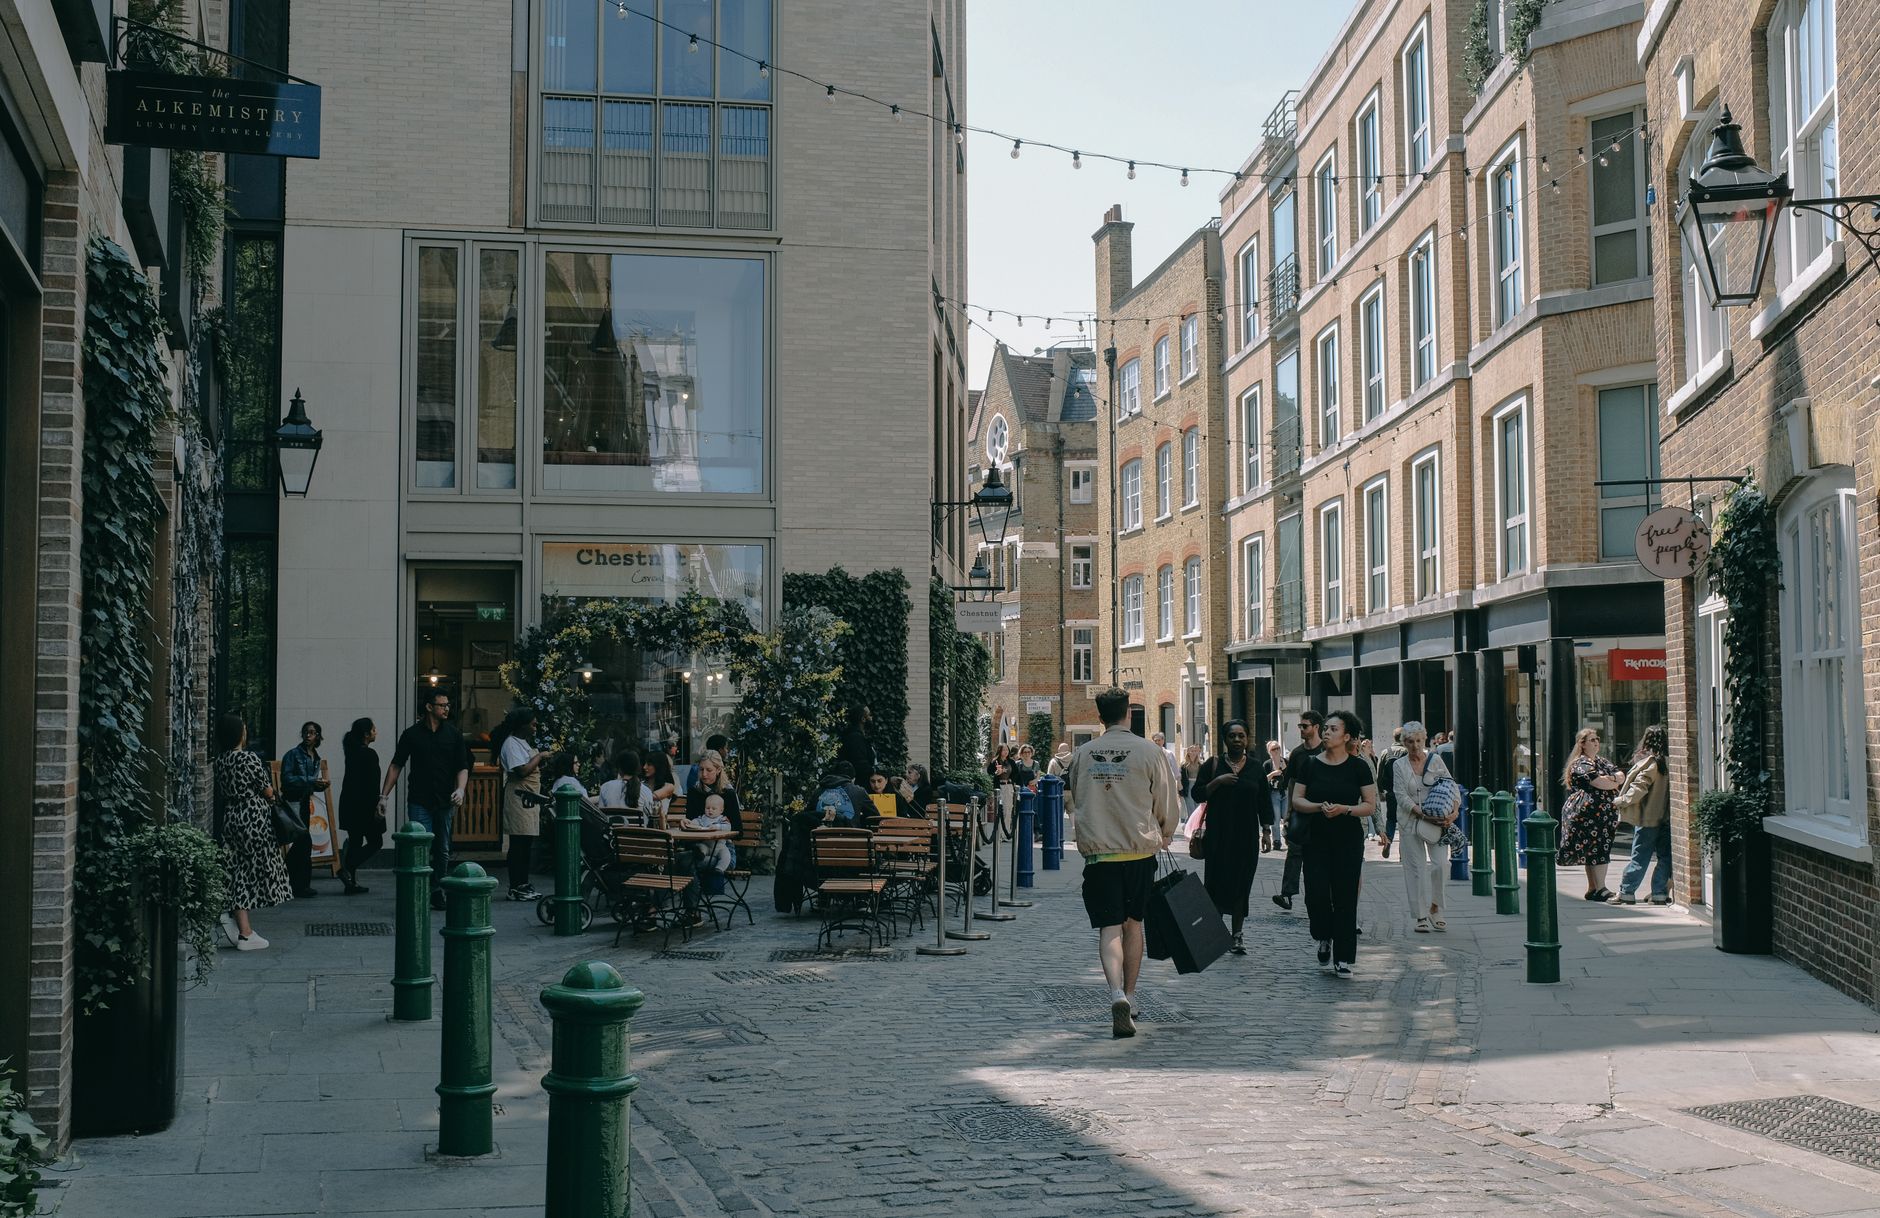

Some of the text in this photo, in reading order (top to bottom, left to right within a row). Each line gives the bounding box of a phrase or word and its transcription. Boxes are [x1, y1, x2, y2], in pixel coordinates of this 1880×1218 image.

[212, 88, 230, 99] the
[136, 99, 303, 124] ALKEMISTRY
[136, 120, 303, 140] LUXURY JEWELLERY
[1641, 517, 1682, 547] free
[576, 549, 687, 566] Chestnt
[1652, 536, 1703, 565] people
